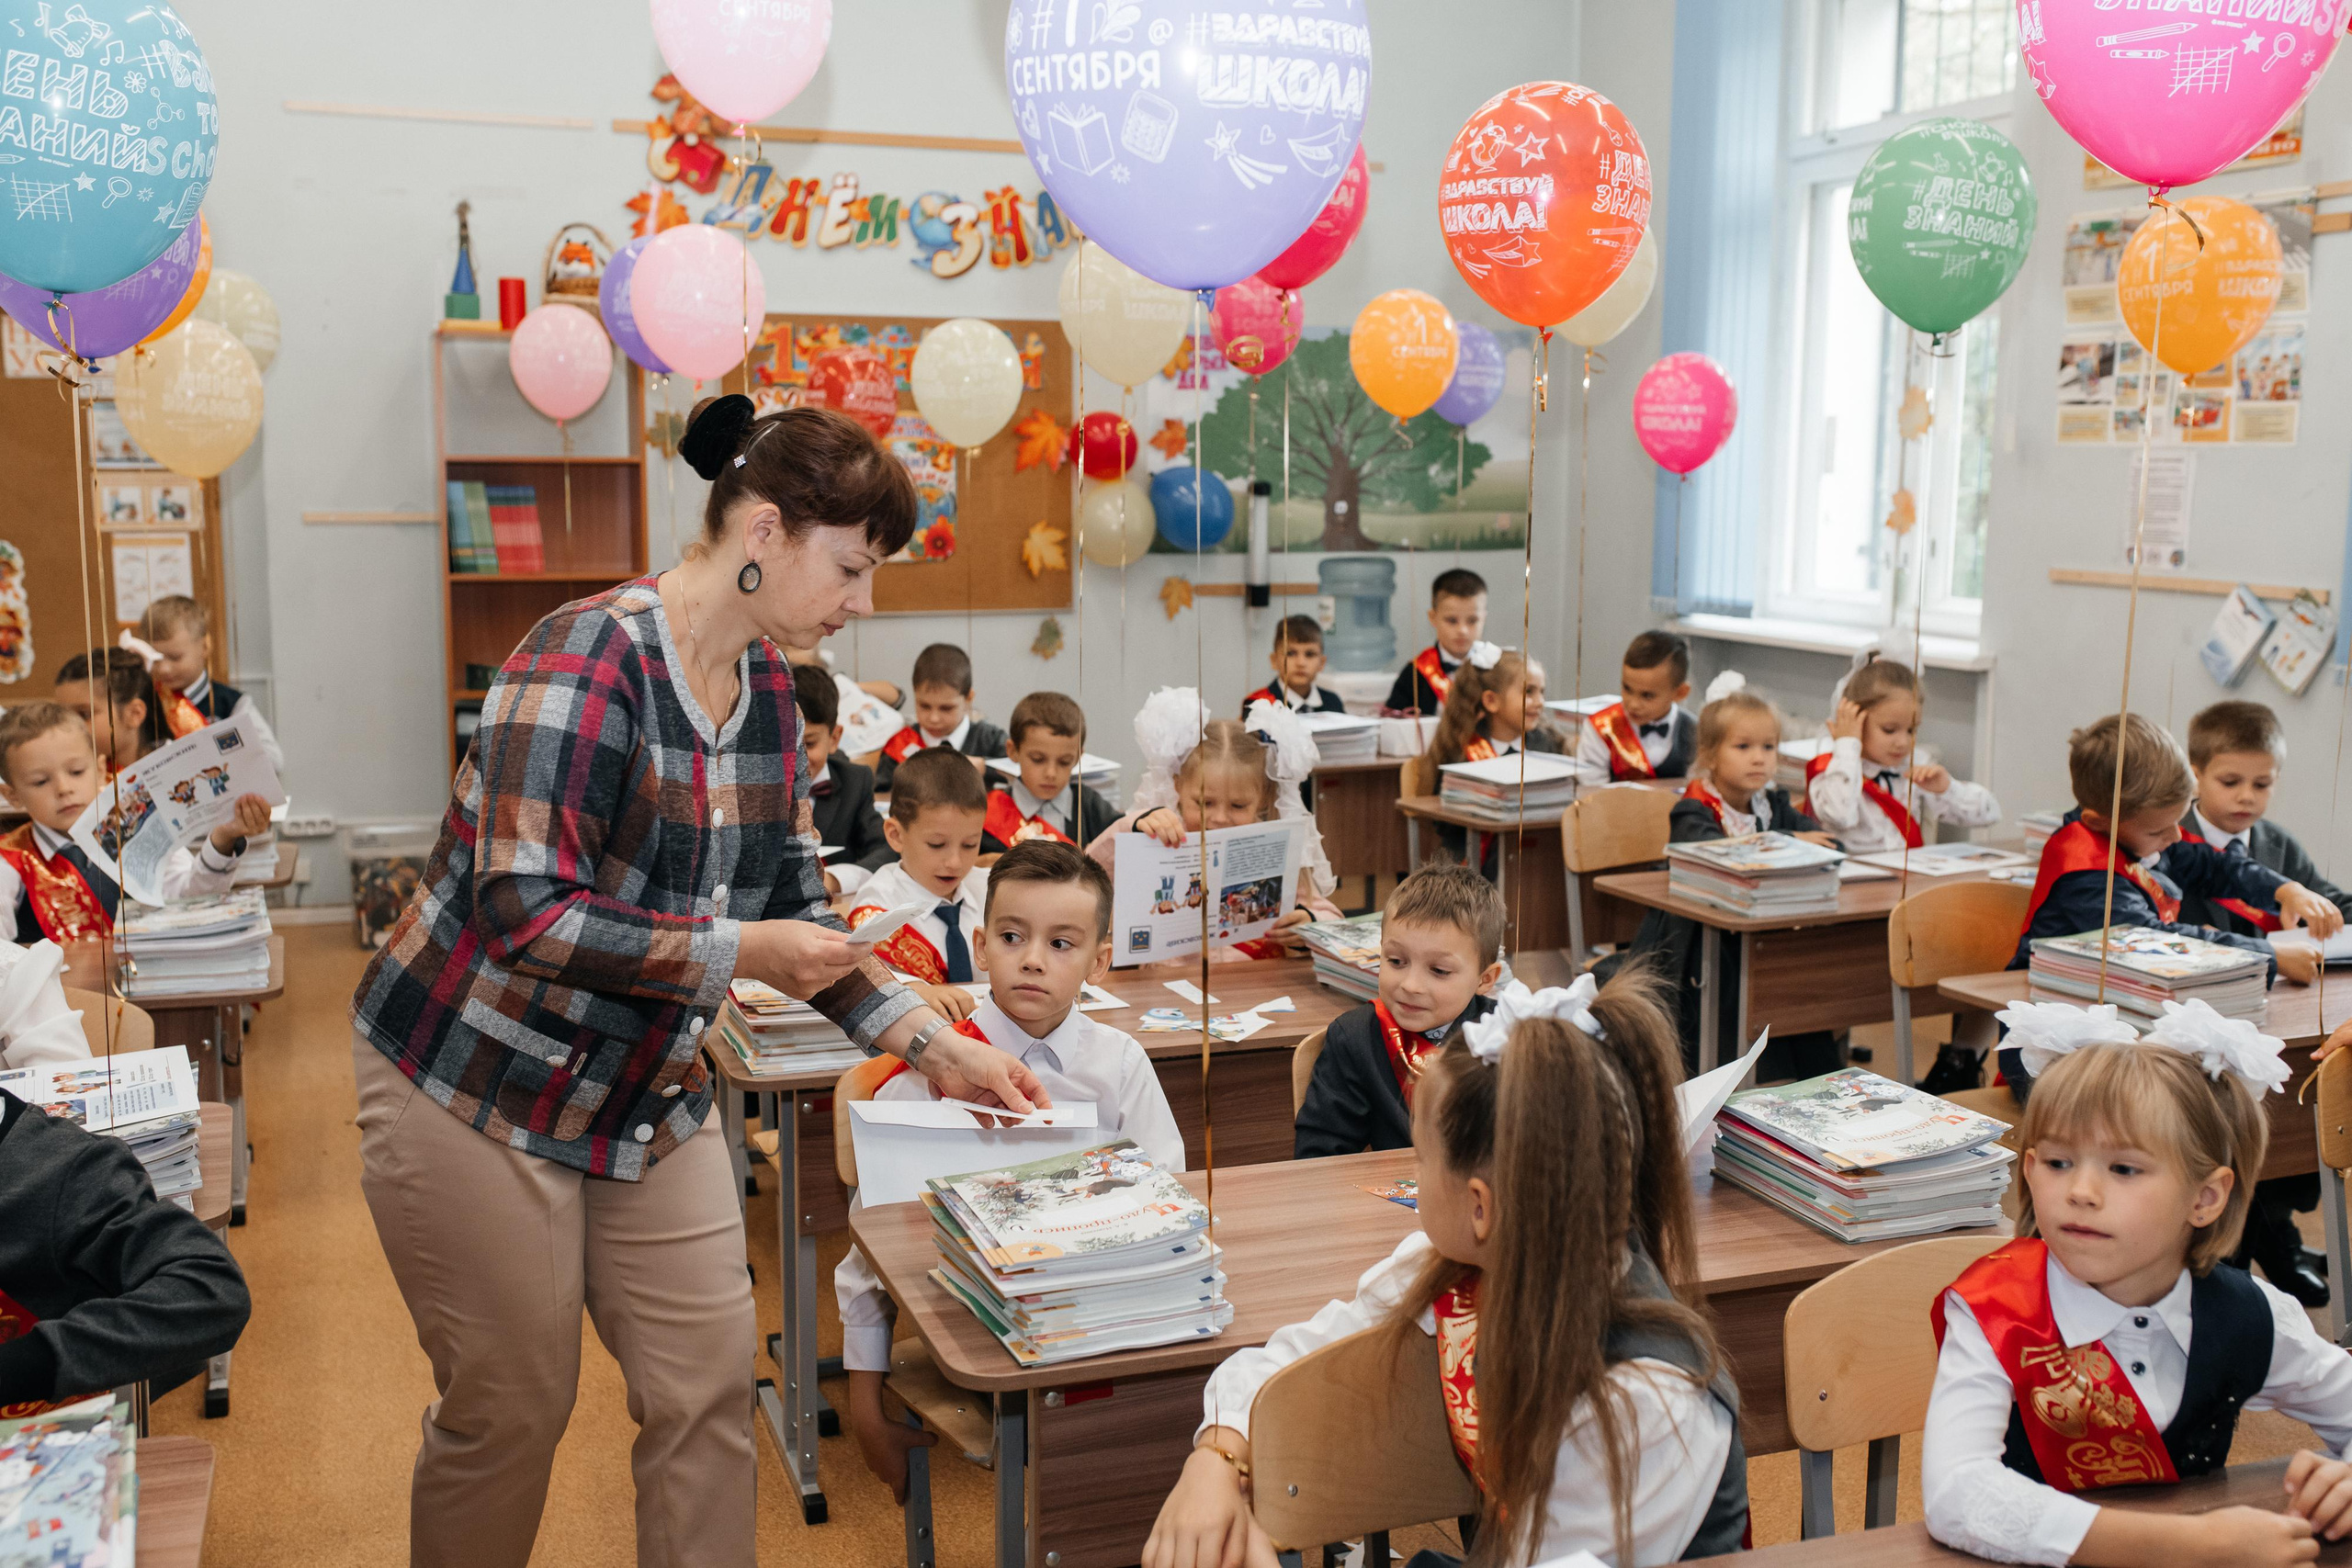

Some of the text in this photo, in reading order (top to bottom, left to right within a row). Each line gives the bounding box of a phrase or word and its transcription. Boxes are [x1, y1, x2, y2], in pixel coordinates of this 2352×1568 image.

[1012, 50, 1160, 96] СЕНТЯБРЯ
[1442, 200, 1548, 237] ШКОЛА!
[1912, 175, 2015, 218] #ДЕНЬ
[703, 164, 901, 250] ДНЁМ
[931, 186, 1089, 280] ЗНА
[1903, 205, 2019, 249] ЗНАНИЙ
